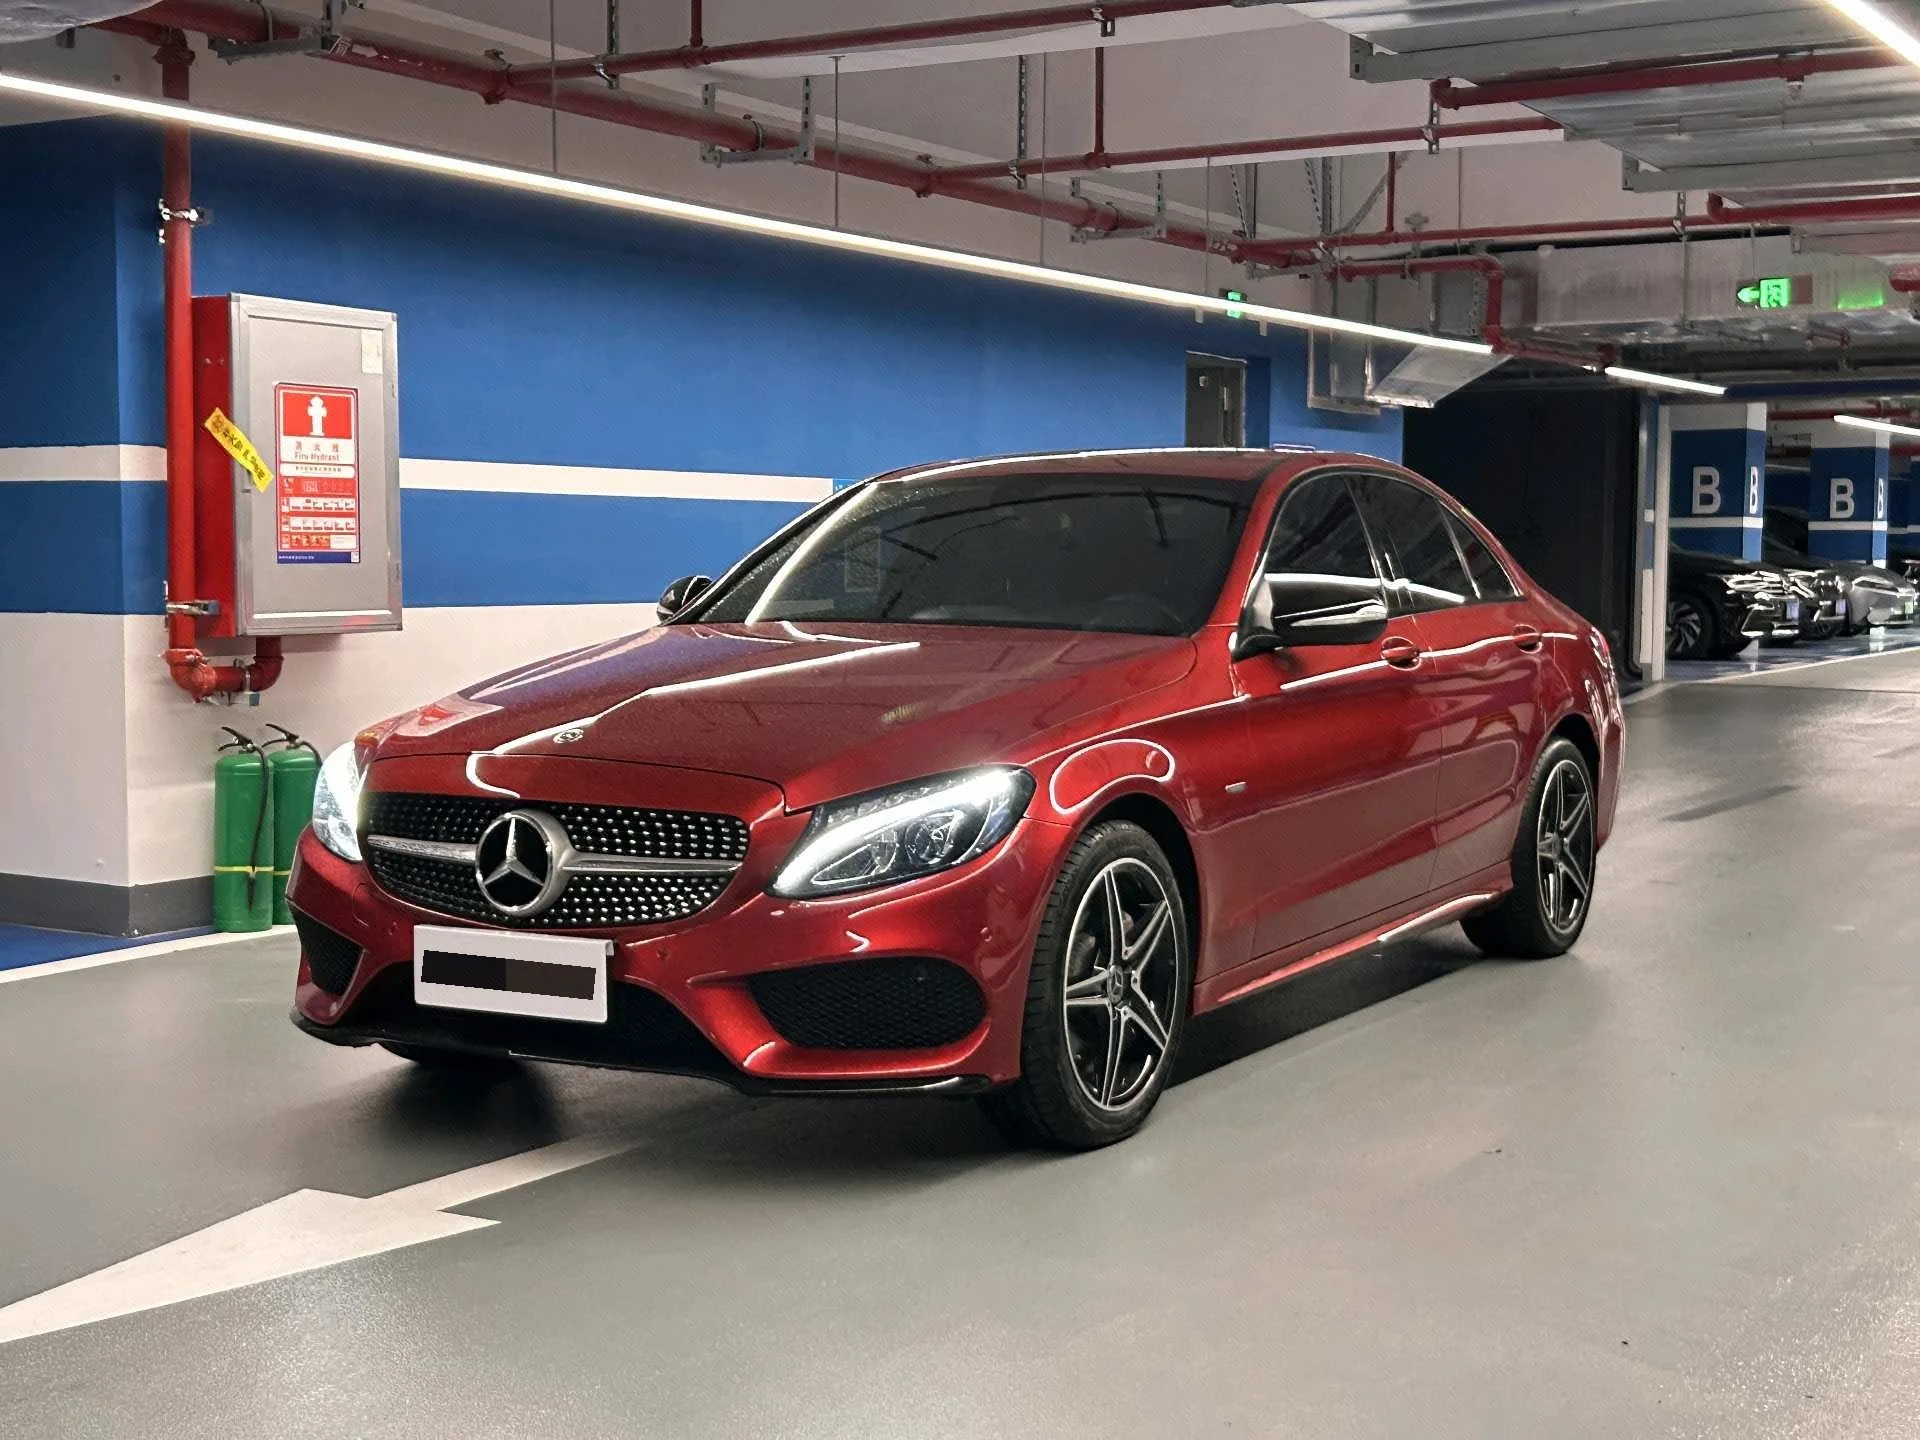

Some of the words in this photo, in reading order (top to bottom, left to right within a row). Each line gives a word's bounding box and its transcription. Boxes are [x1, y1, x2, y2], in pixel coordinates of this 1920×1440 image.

[1691, 466, 1722, 515] B
[1749, 466, 1758, 515] B
[1829, 478, 1855, 519] B
[1877, 477, 1885, 519] B
